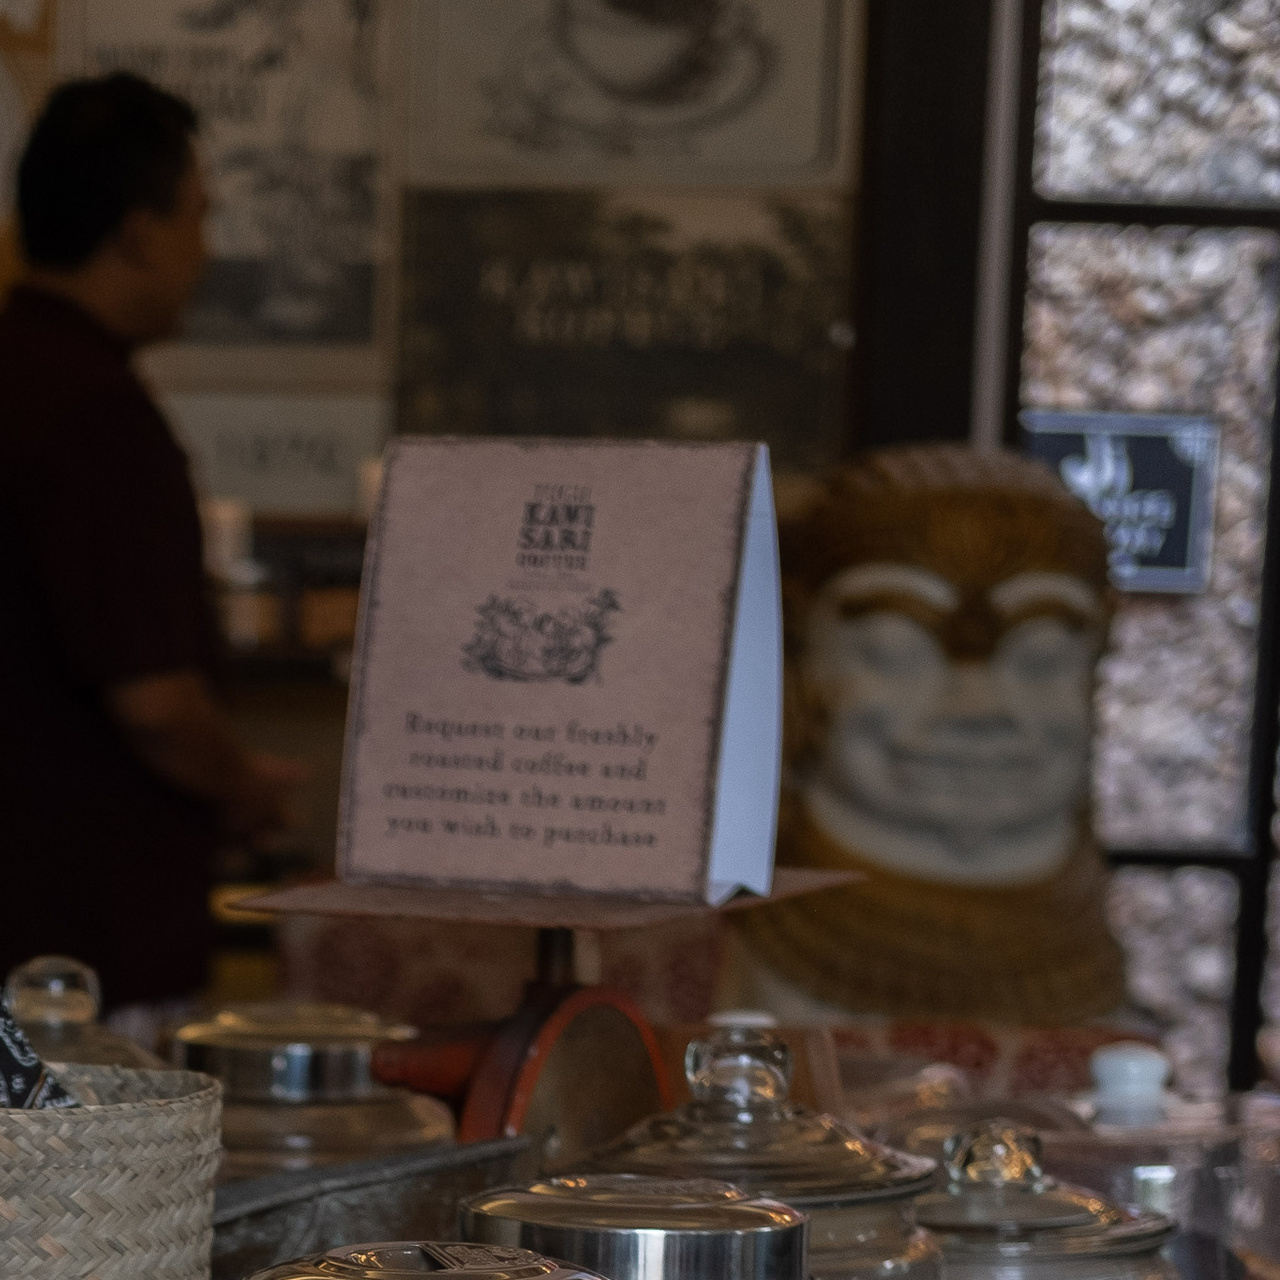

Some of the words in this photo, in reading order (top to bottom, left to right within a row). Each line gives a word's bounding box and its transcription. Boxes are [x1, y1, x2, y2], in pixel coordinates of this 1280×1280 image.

[523, 502, 595, 527] KAWI
[518, 527, 592, 551] SARI
[406, 713, 504, 741] Request
[513, 722, 556, 741] our
[566, 721, 658, 751] freshly
[409, 748, 504, 772] roasted
[511, 752, 590, 776] coffee
[600, 758, 647, 780] and
[520, 785, 561, 807] the
[571, 794, 666, 814] amount
[384, 816, 432, 838] you
[442, 815, 501, 838] wish
[510, 823, 536, 840] to
[544, 823, 658, 847] purchase
